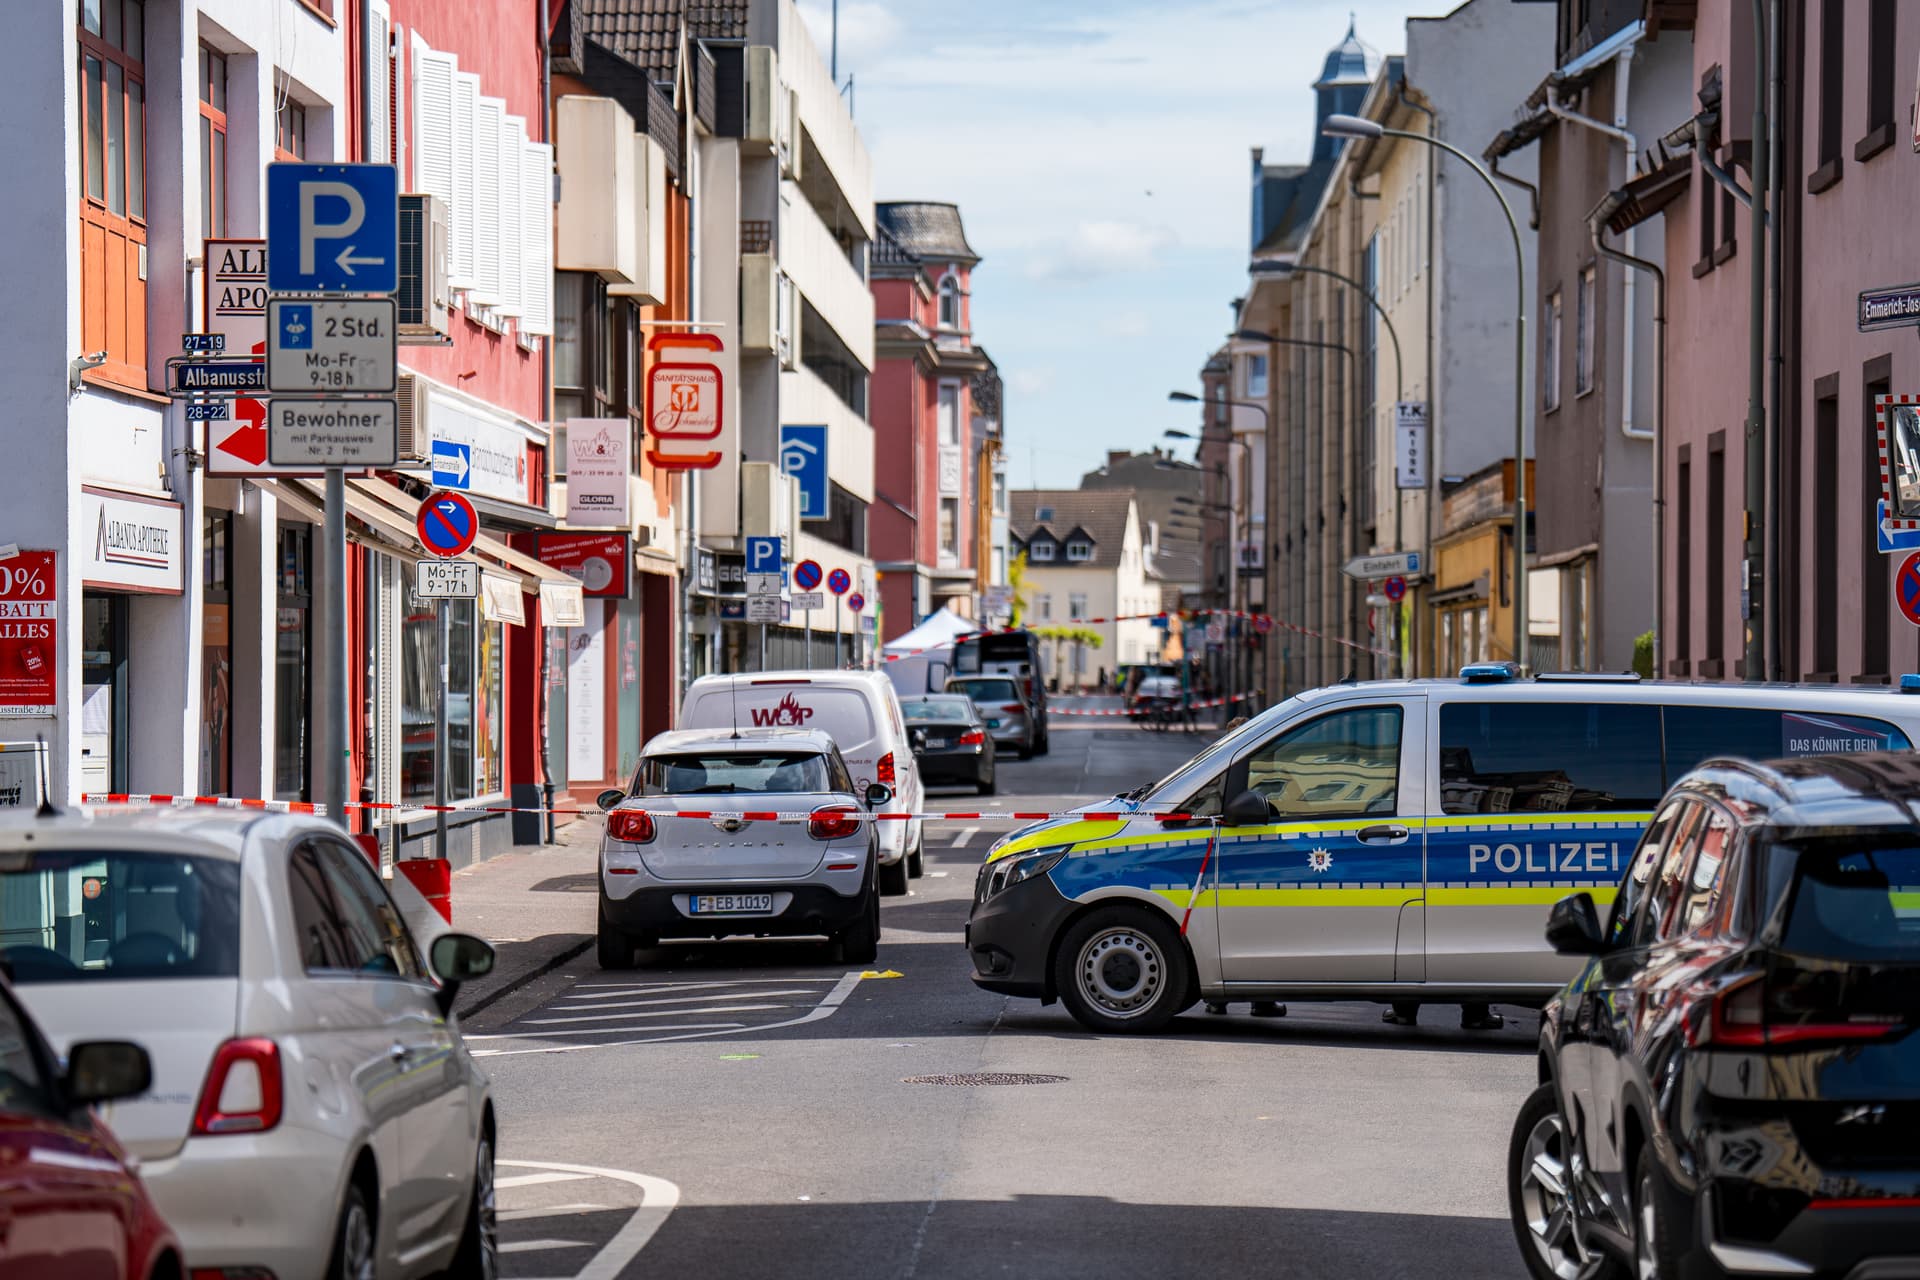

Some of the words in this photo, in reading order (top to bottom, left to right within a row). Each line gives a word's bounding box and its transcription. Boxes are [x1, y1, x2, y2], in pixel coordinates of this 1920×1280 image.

[300, 181, 365, 275] P
[325, 318, 336, 337] 2
[342, 317, 385, 337] Std.
[185, 336, 223, 349] 27-19
[306, 353, 356, 367] Mo-Fr
[310, 372, 342, 385] 9-18
[346, 372, 354, 385] h
[655, 374, 716, 383] SANITÄTSHAUS
[187, 407, 225, 419] 28-22
[283, 411, 382, 427] Bewohner
[291, 434, 306, 443] mit
[310, 434, 373, 443] Parkausweis
[342, 446, 360, 455] frei
[1408, 429, 1417, 475] KIOSK
[107, 520, 137, 550] ALBANUS
[138, 525, 168, 555] APOTHEKE
[754, 541, 774, 569] P
[428, 566, 467, 578] Mo-Fr
[1363, 559, 1401, 572] Einfahrt
[462, 581, 467, 592] h
[36, 705, 47, 713] 22
[751, 707, 813, 727] W&P
[1790, 739, 1810, 752] DAS
[1812, 736, 1851, 752] KÖNNTE
[1854, 739, 1878, 752] DEIN
[1469, 843, 1619, 873] POLIZEI
[699, 897, 707, 910] F
[716, 896, 734, 910] EB
[736, 896, 769, 909] 1019
